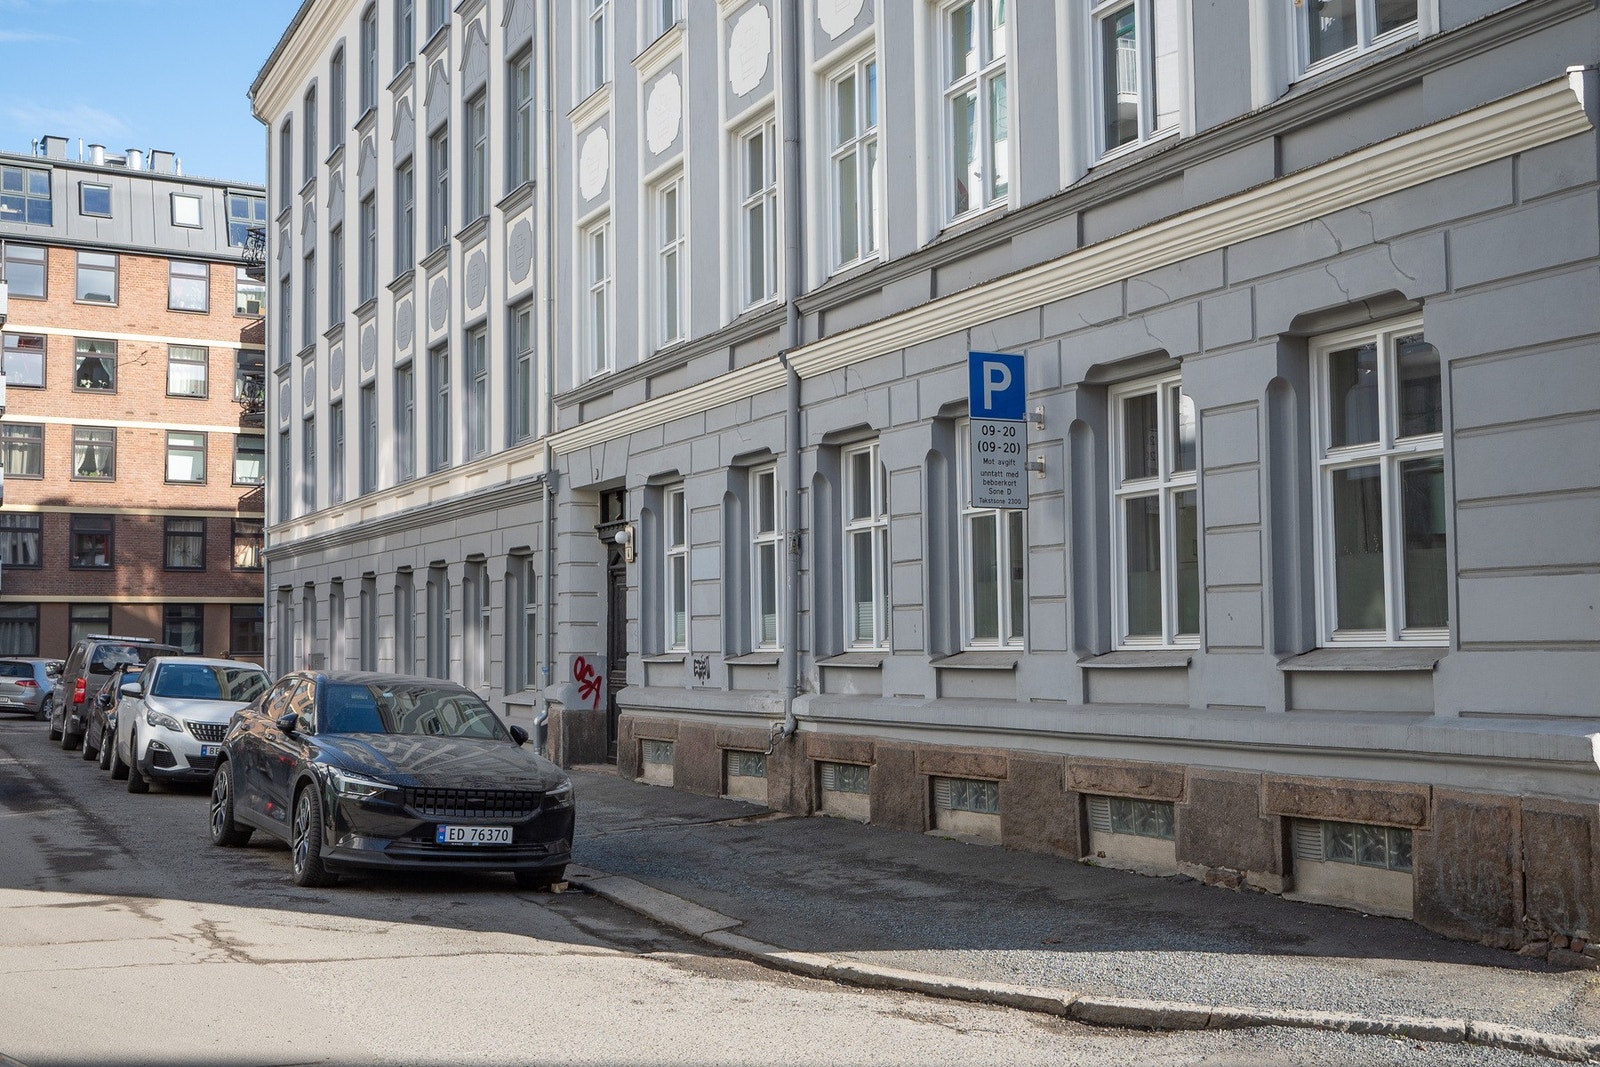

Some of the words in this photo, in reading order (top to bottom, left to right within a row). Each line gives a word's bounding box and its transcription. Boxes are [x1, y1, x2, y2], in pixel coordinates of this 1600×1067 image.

[983, 361, 1012, 410] P
[982, 457, 995, 465] Mot
[997, 458, 1016, 467] avgift
[982, 478, 1017, 487] beboerkort
[449, 828, 465, 841] ED
[470, 828, 509, 842] 76370
